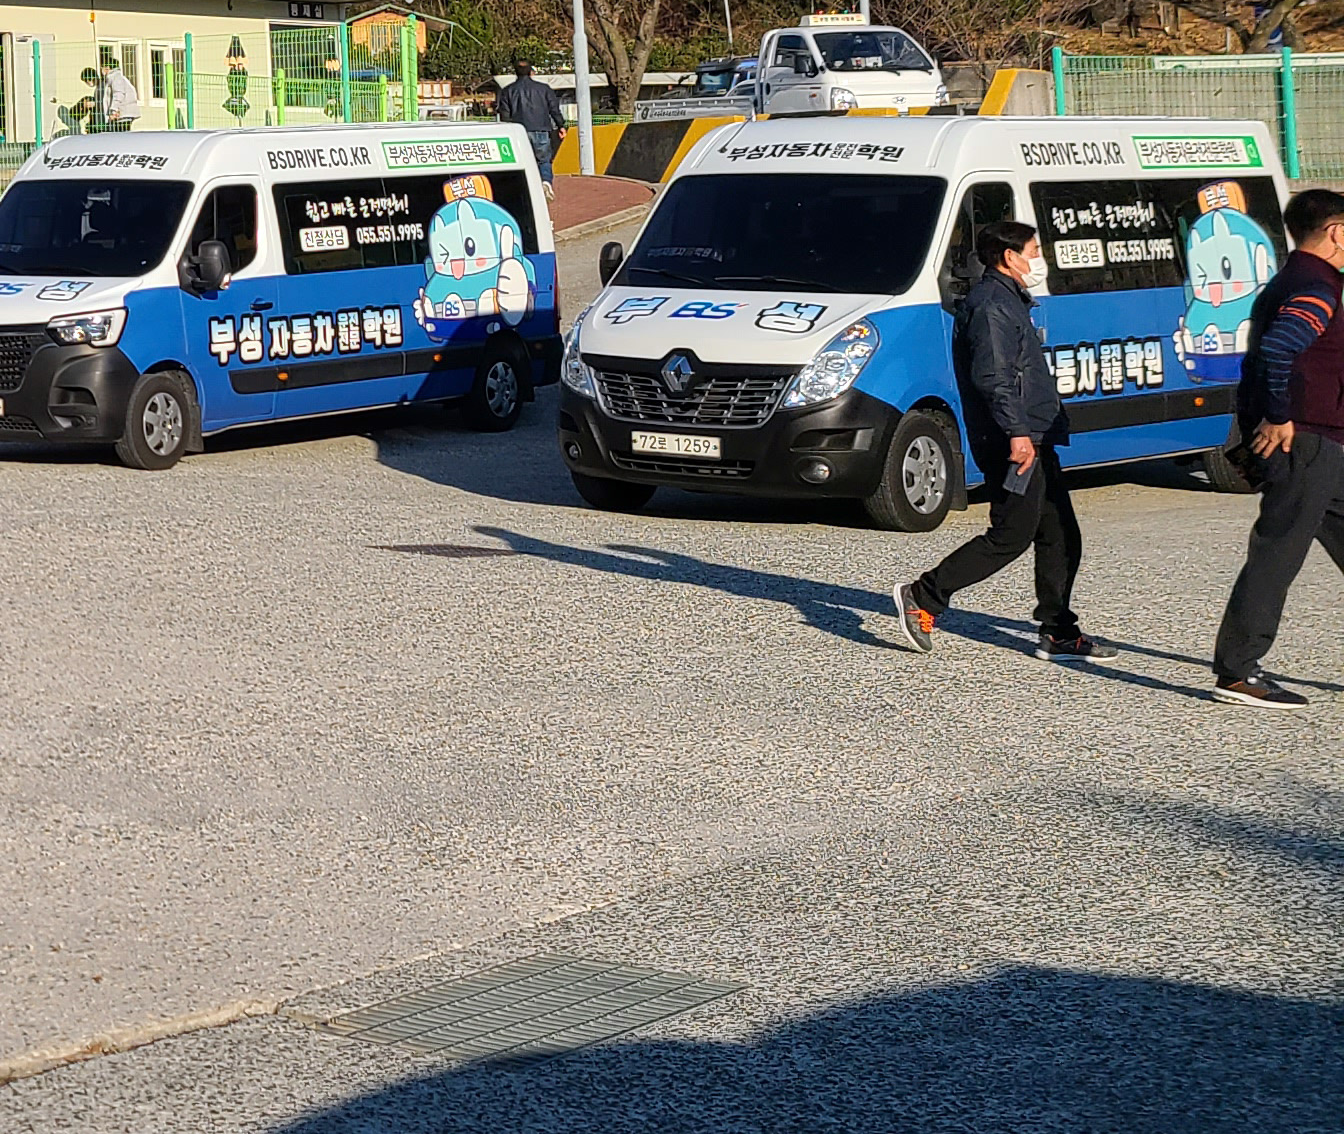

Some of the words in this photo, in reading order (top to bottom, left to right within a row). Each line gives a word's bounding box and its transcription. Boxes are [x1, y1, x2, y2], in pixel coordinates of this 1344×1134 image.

[267, 147, 372, 170] BSDRIVE.CO.KR
[727, 142, 833, 162] 부성자동차
[856, 143, 904, 163] 학원
[1020, 142, 1125, 166] BSDRIVE.CO.KR
[450, 178, 477, 198] 부성
[305, 200, 330, 223] 쉽고
[331, 196, 358, 218] 빠른
[359, 193, 409, 218] 운전면허!
[1051, 207, 1077, 234] 쉽고
[1078, 202, 1105, 229] 빠른
[1105, 200, 1155, 230] 운전면허!
[304, 229, 344, 248] 친절상담
[355, 223, 424, 245] 055.551.9995
[1059, 242, 1100, 265] 친절상담
[1107, 238, 1175, 263] 055.551.9995
[36, 281, 94, 301] 성
[445, 301, 460, 316] BS
[604, 297, 672, 324] 부
[667, 302, 748, 320] BS
[755, 301, 830, 334] 성
[210, 315, 263, 364] 부성
[269, 313, 335, 358] 자동차
[363, 306, 402, 346] 학원
[1045, 345, 1099, 395] 동차
[1124, 340, 1164, 386] 학원
[639, 434, 667, 450] 72로
[674, 437, 711, 454] 1259
